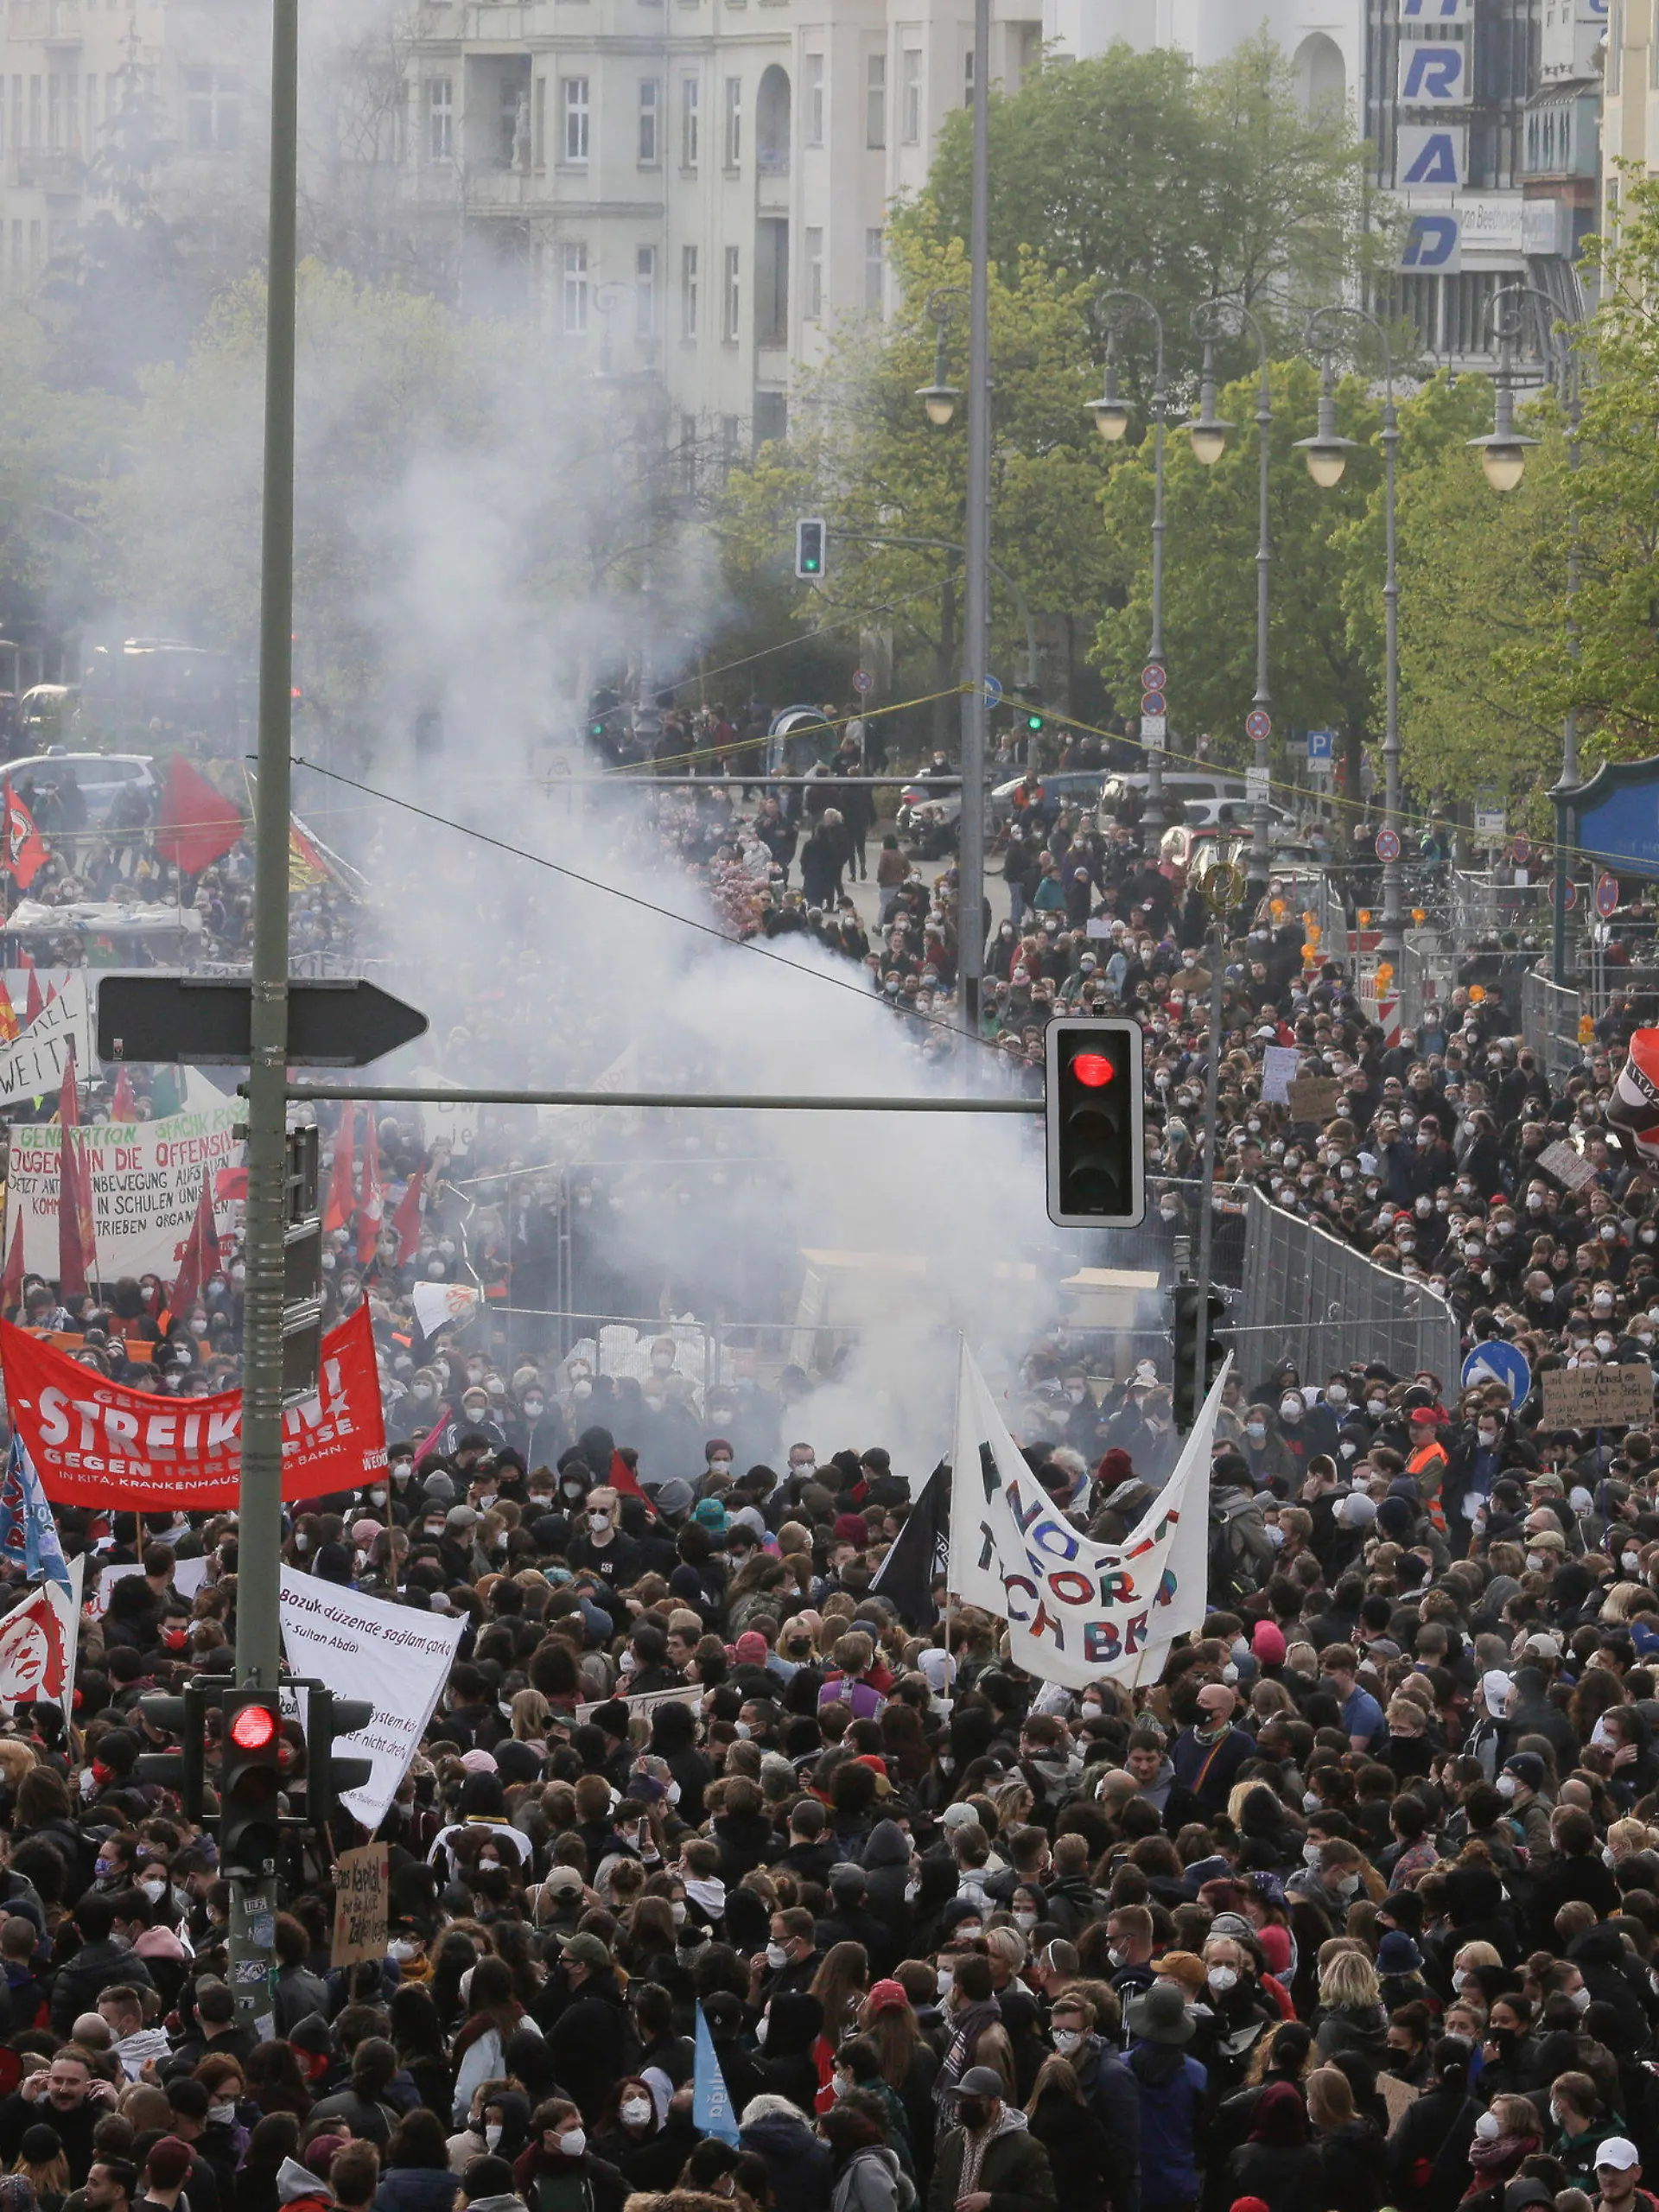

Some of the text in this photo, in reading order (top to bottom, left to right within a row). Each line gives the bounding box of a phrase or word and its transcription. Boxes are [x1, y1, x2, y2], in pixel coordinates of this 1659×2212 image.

[1313, 735, 1326, 754] P
[11, 1146, 61, 1174] JUGEN
[115, 1146, 143, 1171] DIE
[98, 1196, 109, 1215] IN
[114, 1192, 174, 1215] SCHULEN
[96, 1218, 147, 1237] TRIEBEN
[43, 1448, 152, 1478] GEGEN
[282, 1417, 360, 1457] RISE.
[58, 1471, 73, 1481] IN
[297, 1446, 347, 1465] BAHN.
[362, 1453, 388, 1471] WEDD
[279, 1588, 321, 1614] Bozuk
[323, 1605, 382, 1636] düzende
[293, 1624, 327, 1644] Sultan
[361, 1733, 388, 1751] nicht
